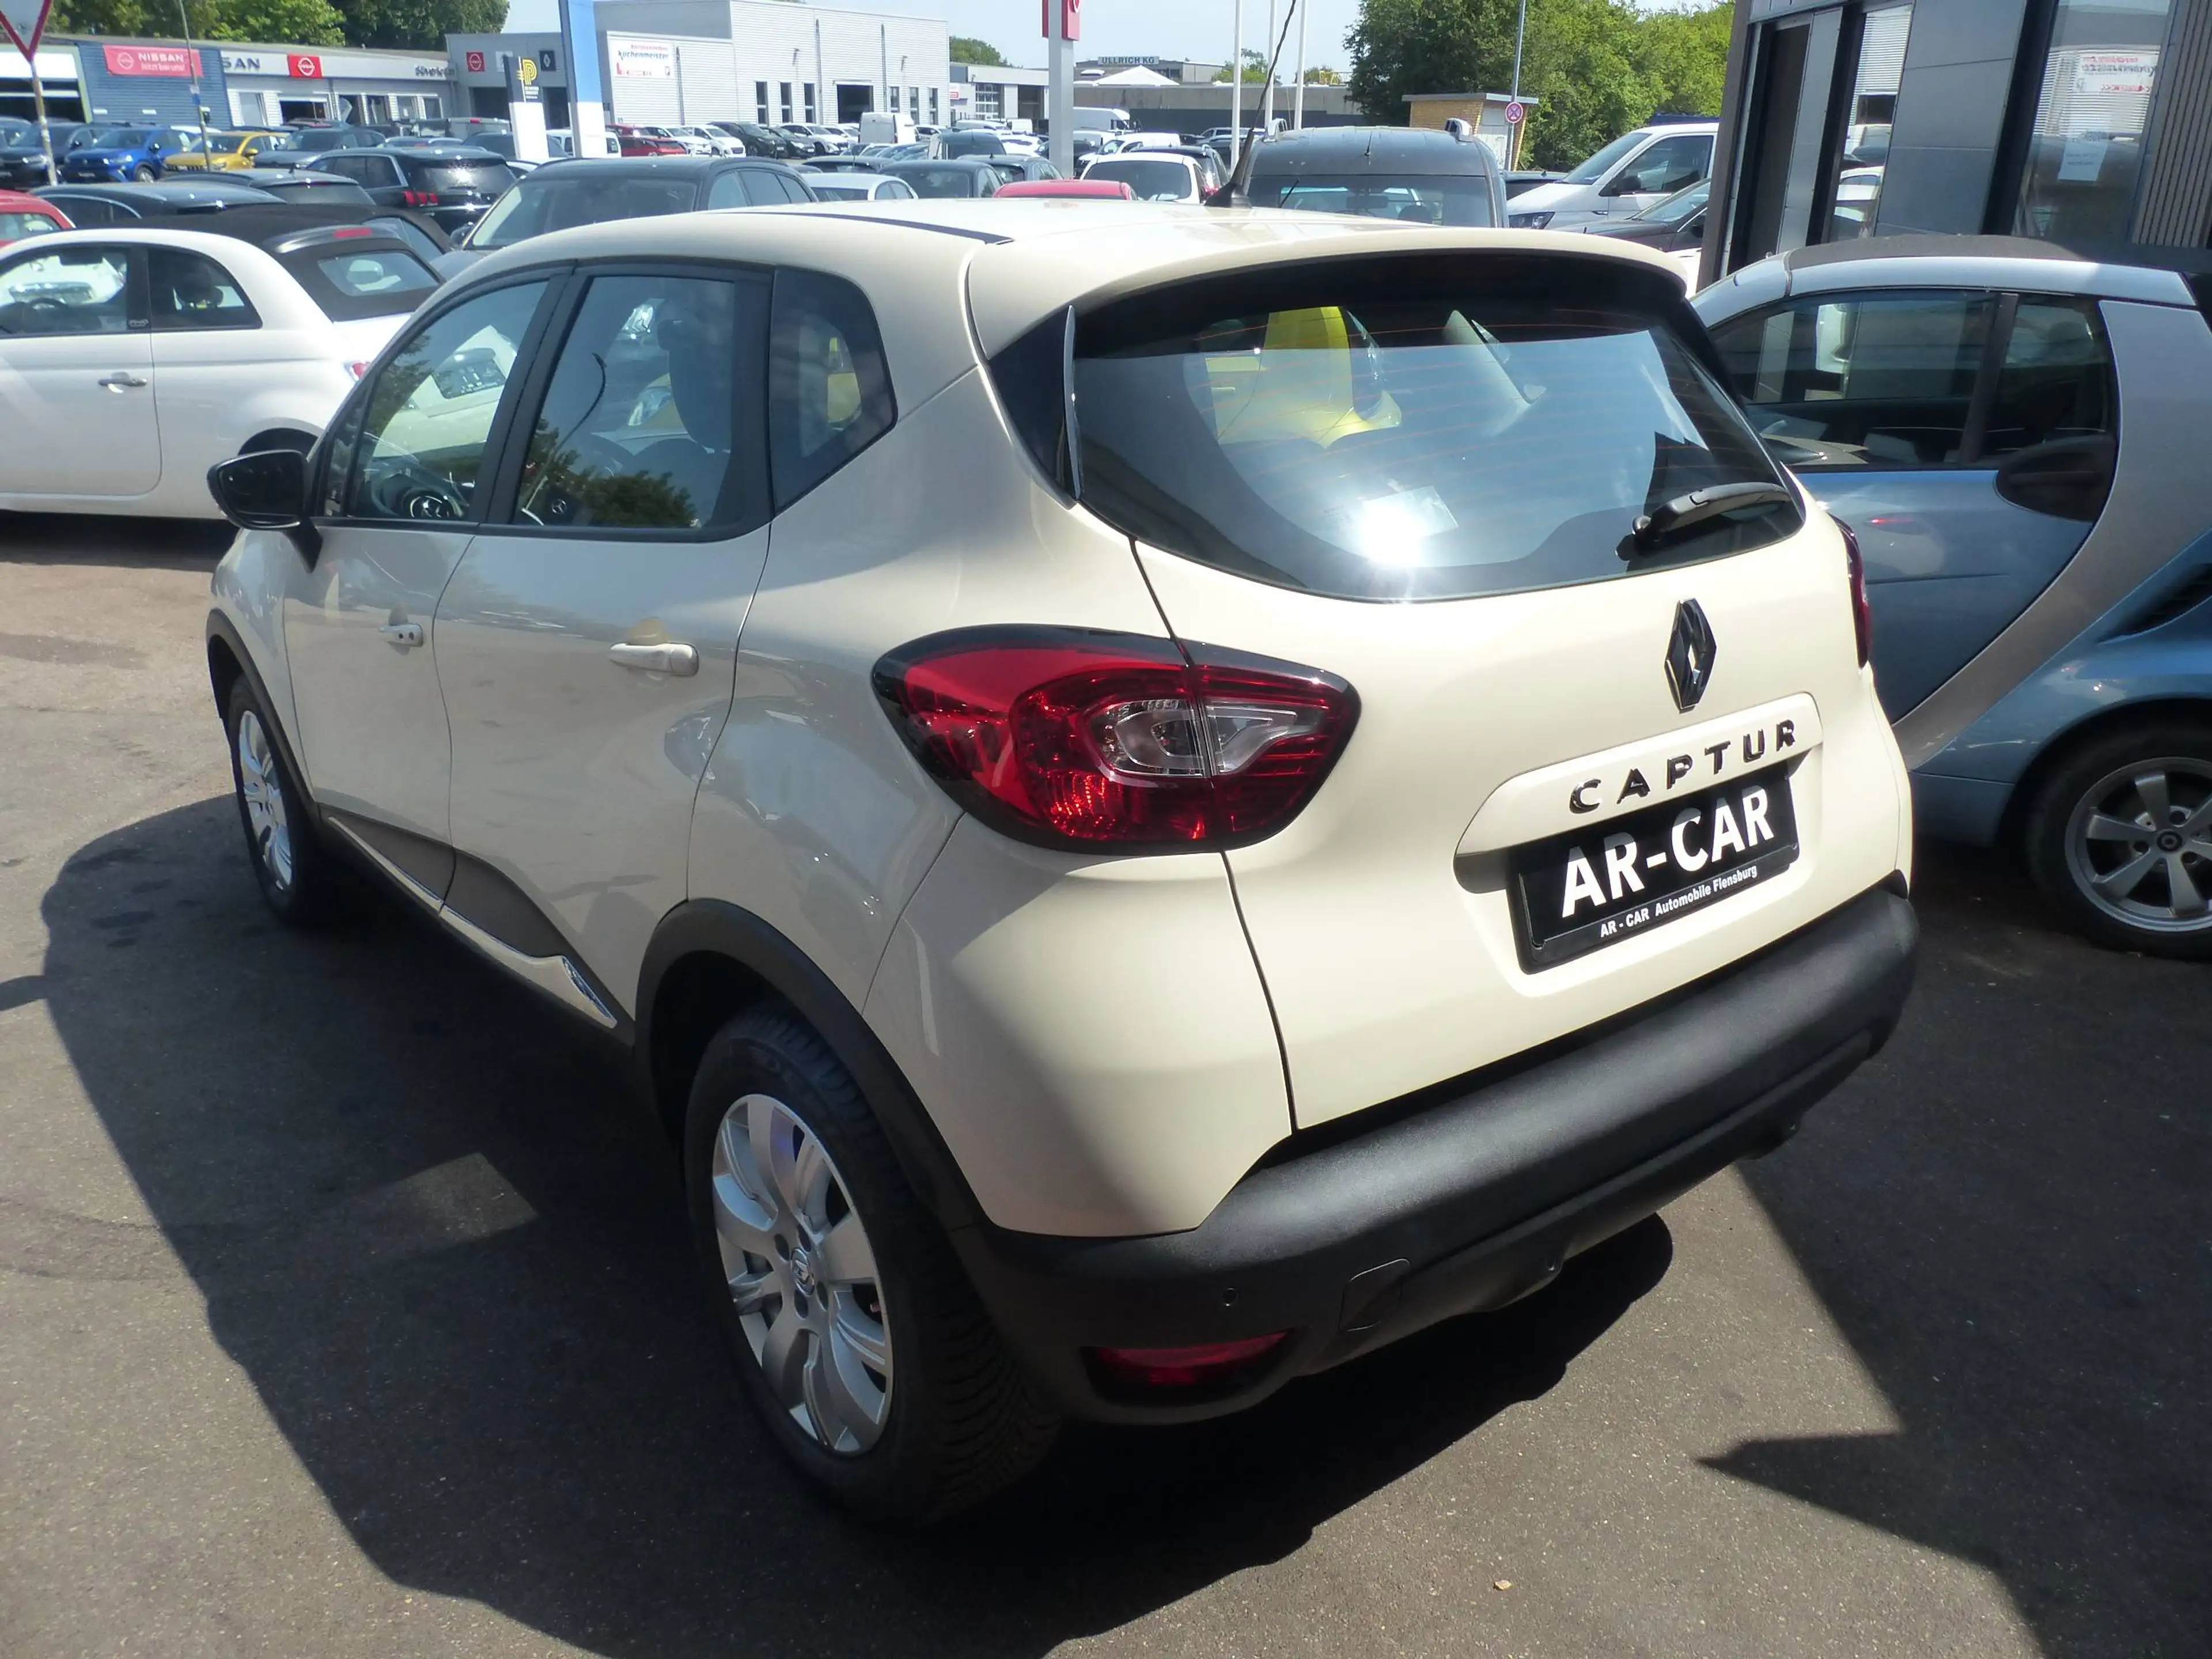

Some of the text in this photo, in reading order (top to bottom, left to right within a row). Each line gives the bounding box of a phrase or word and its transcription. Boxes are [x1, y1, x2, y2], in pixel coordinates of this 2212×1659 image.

[138, 52, 184, 62] NISSAN
[1569, 719, 1796, 814] CAPTUR
[1562, 784, 1775, 918] AR-CAR
[1600, 920, 1618, 938] AR
[1626, 908, 1650, 927] CAR
[1655, 884, 1711, 916] Automobile
[1713, 865, 1758, 893] Flensburg
